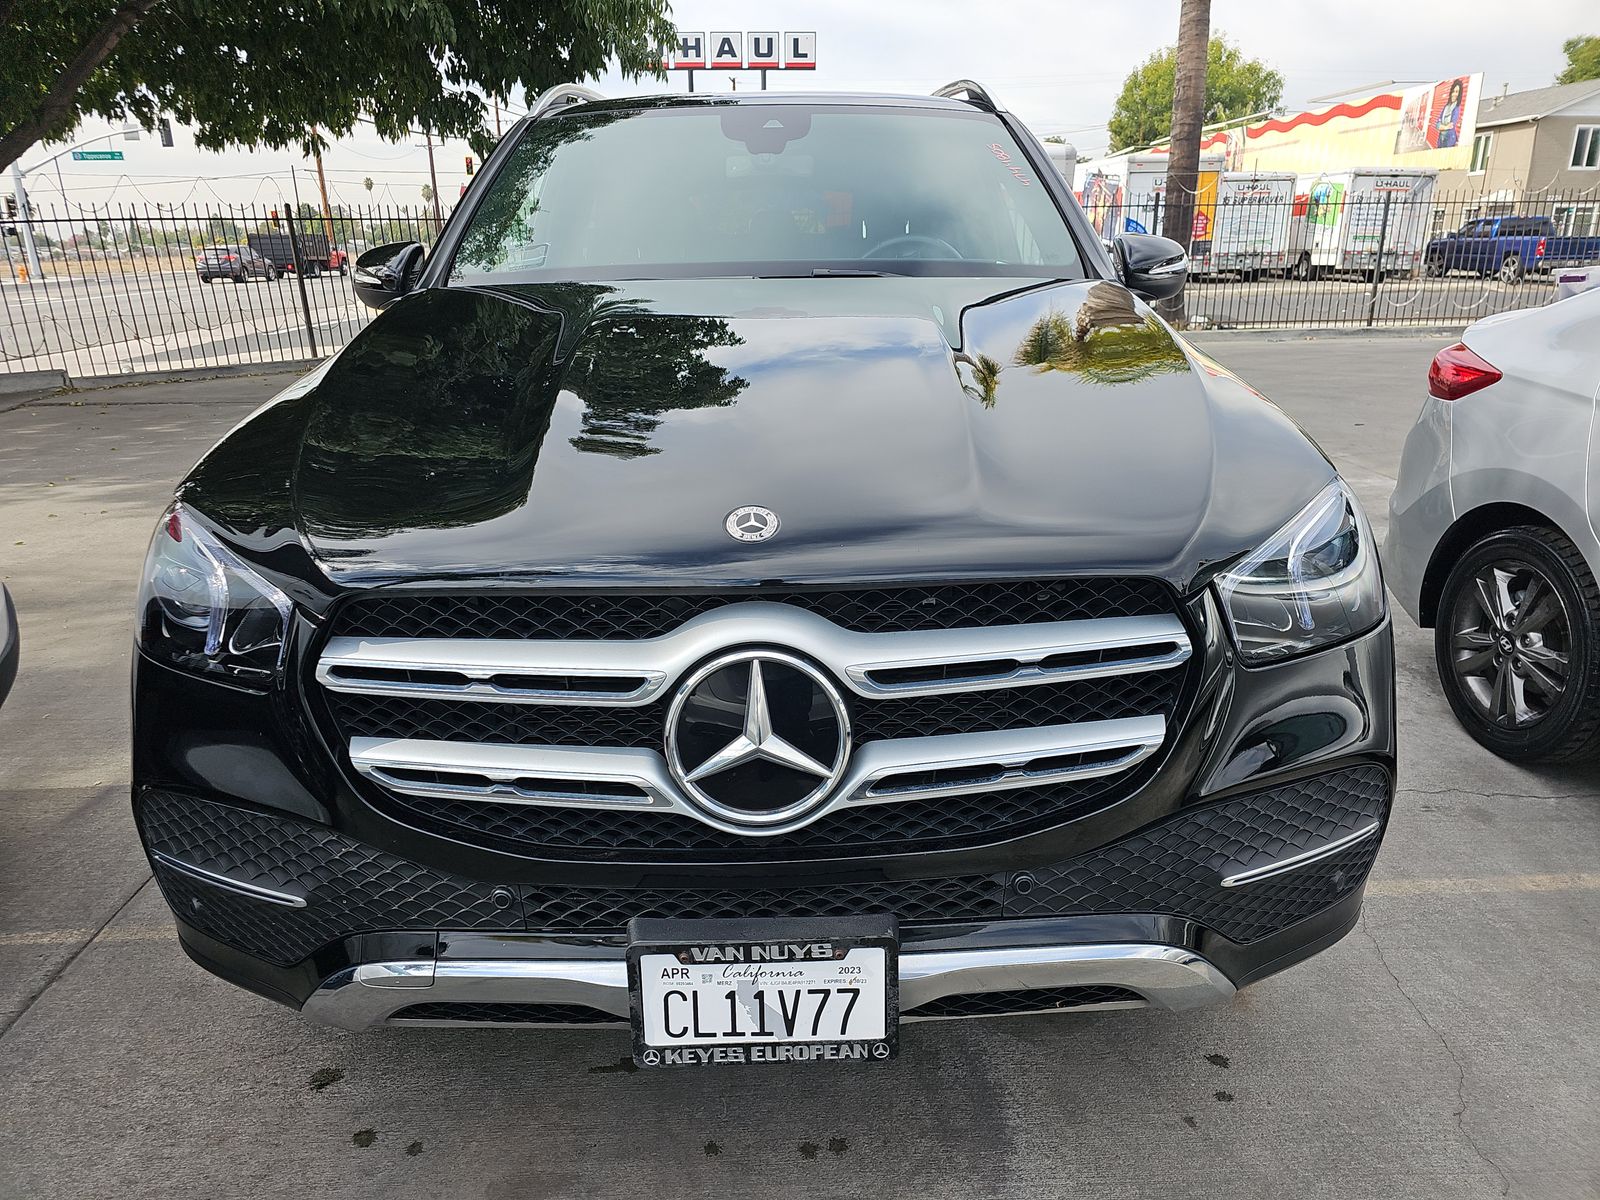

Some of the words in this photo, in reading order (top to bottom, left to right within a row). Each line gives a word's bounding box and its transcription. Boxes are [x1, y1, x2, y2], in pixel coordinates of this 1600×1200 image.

[690, 945, 744, 962] VAN
[751, 943, 833, 960] NUYS
[661, 967, 691, 979] APR
[722, 964, 805, 986] California
[838, 966, 862, 975] 2023
[663, 988, 861, 1038] CL11V77
[665, 1046, 745, 1064] KEYES
[750, 1043, 869, 1062] EUROPEAN
